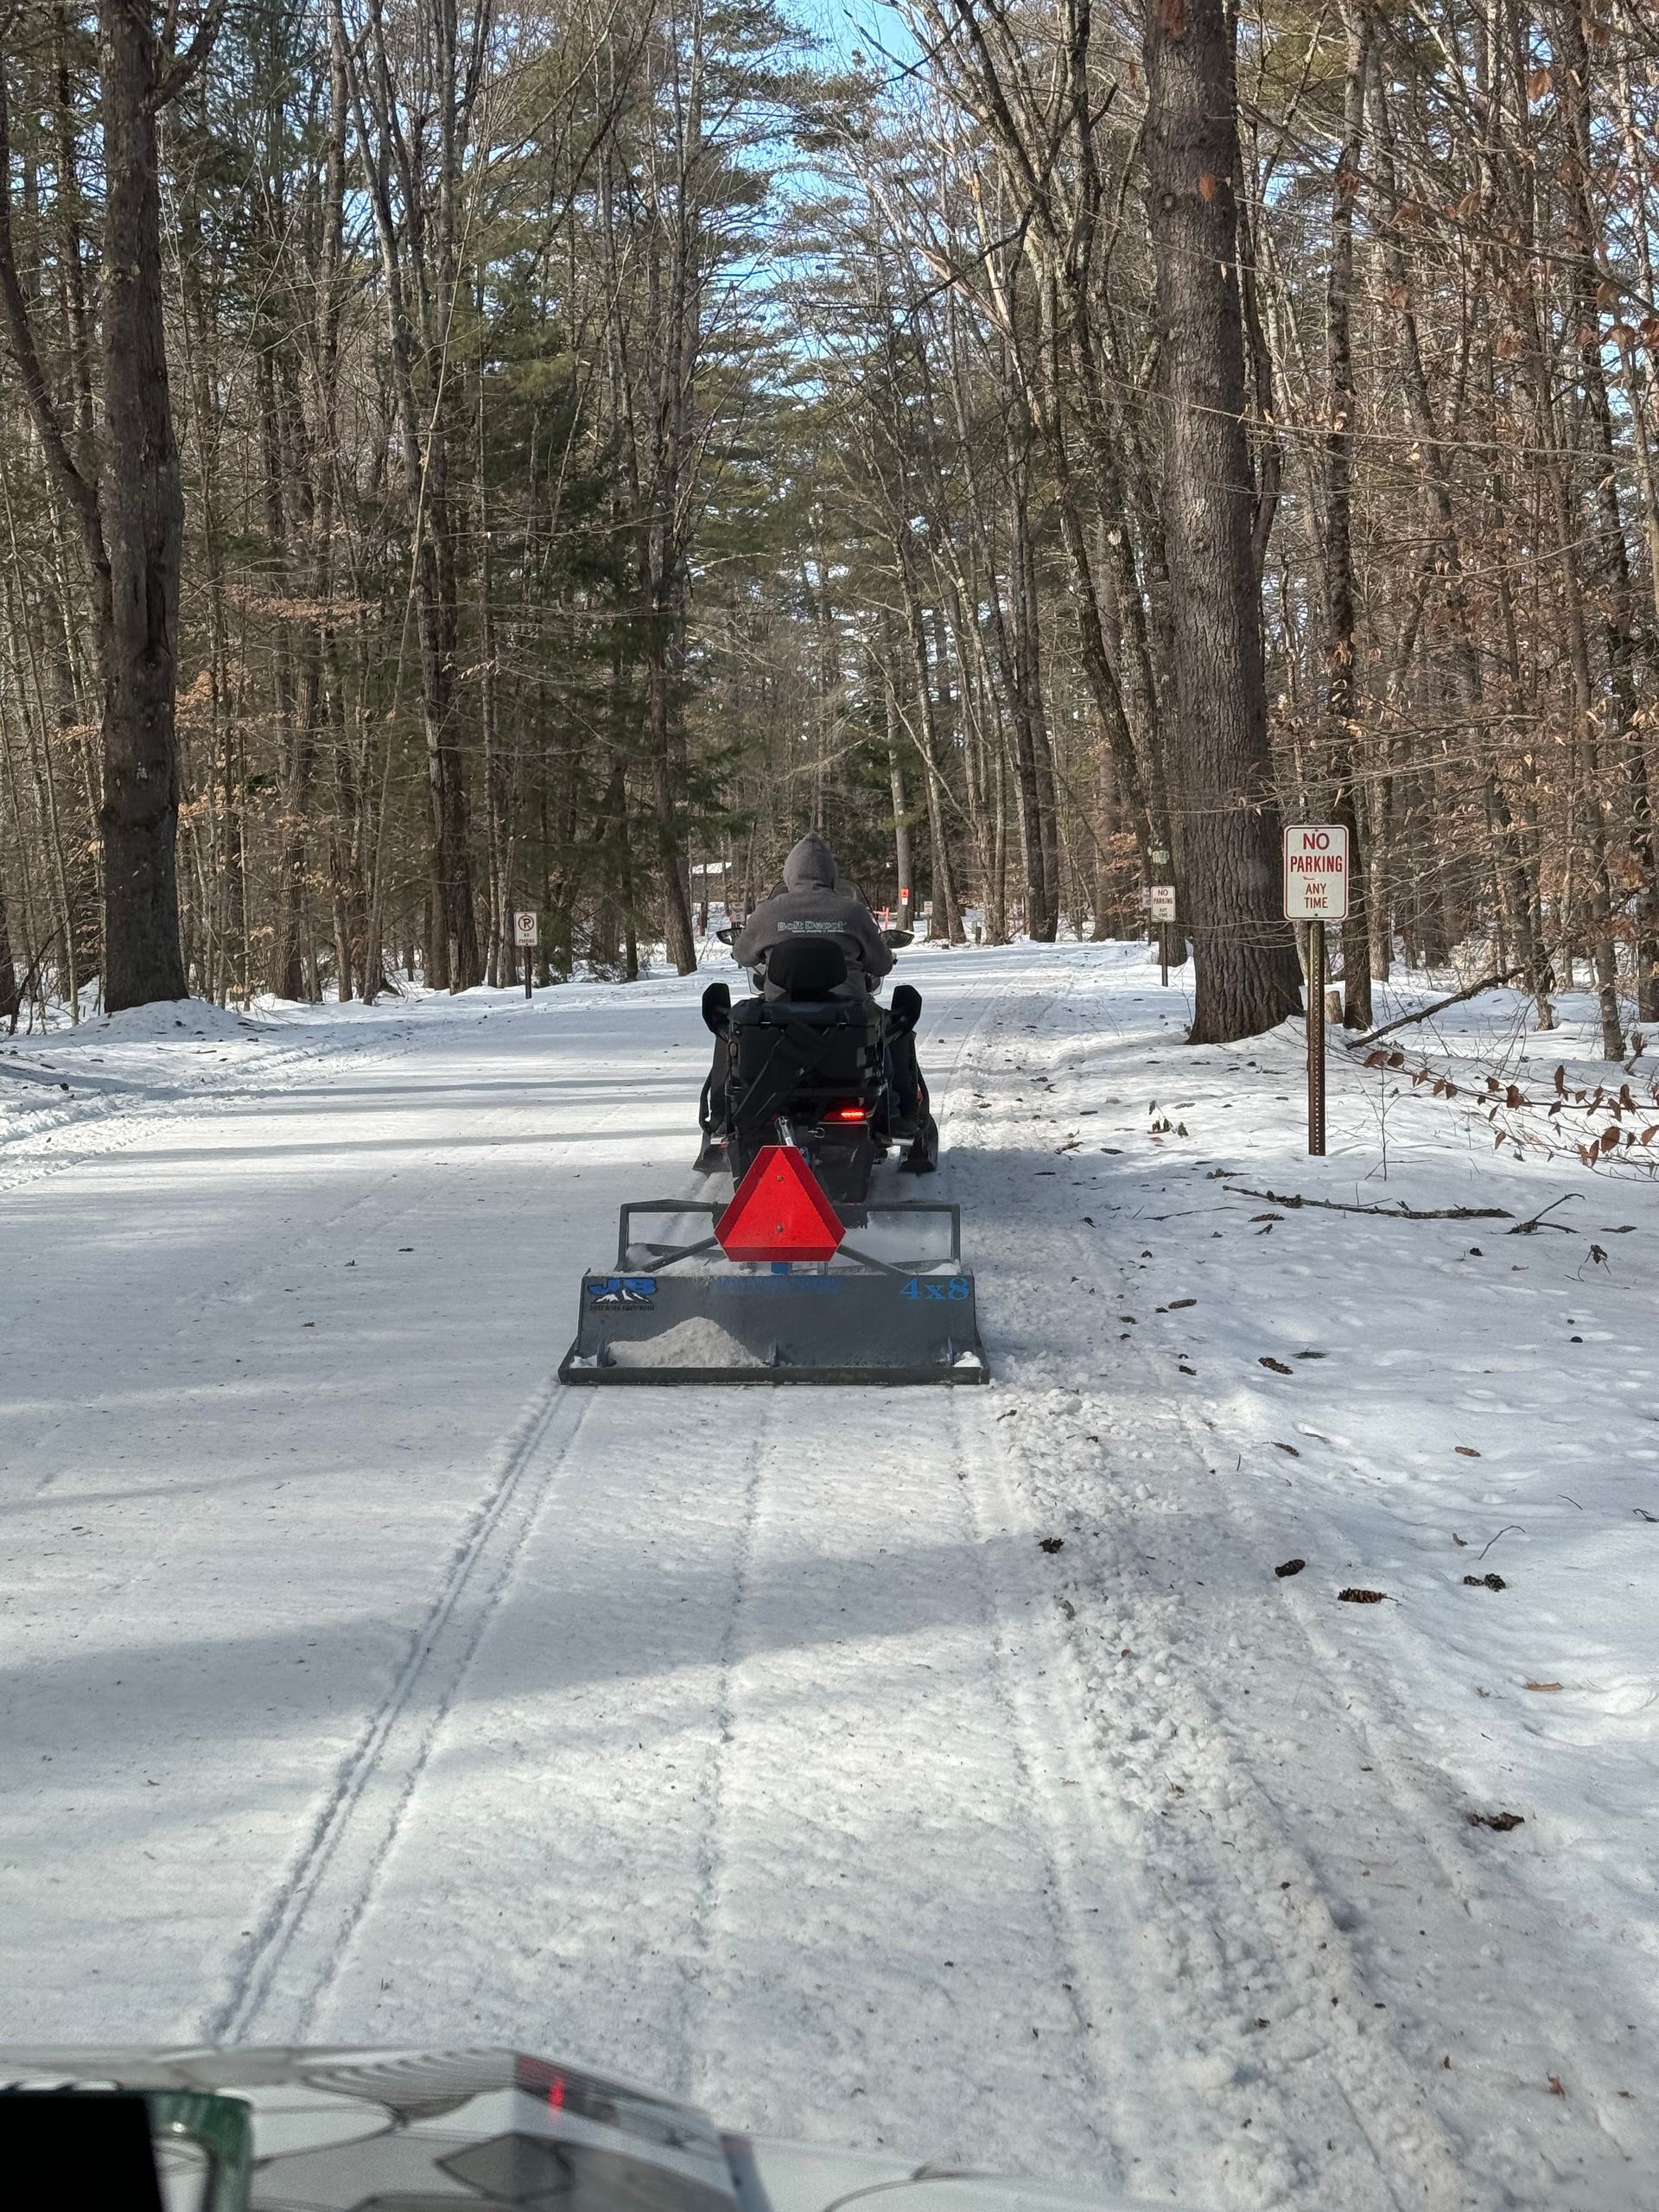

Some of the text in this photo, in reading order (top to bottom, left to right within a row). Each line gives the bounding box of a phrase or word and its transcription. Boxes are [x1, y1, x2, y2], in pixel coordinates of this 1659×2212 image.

[1302, 832, 1331, 850] NO
[1290, 855, 1343, 873] PARKING
[1305, 883, 1327, 895] ANY
[1304, 897, 1329, 909] TIME
[777, 920, 804, 931] Bolt
[804, 920, 844, 931] Depot
[899, 1276, 969, 1300] 4x8
